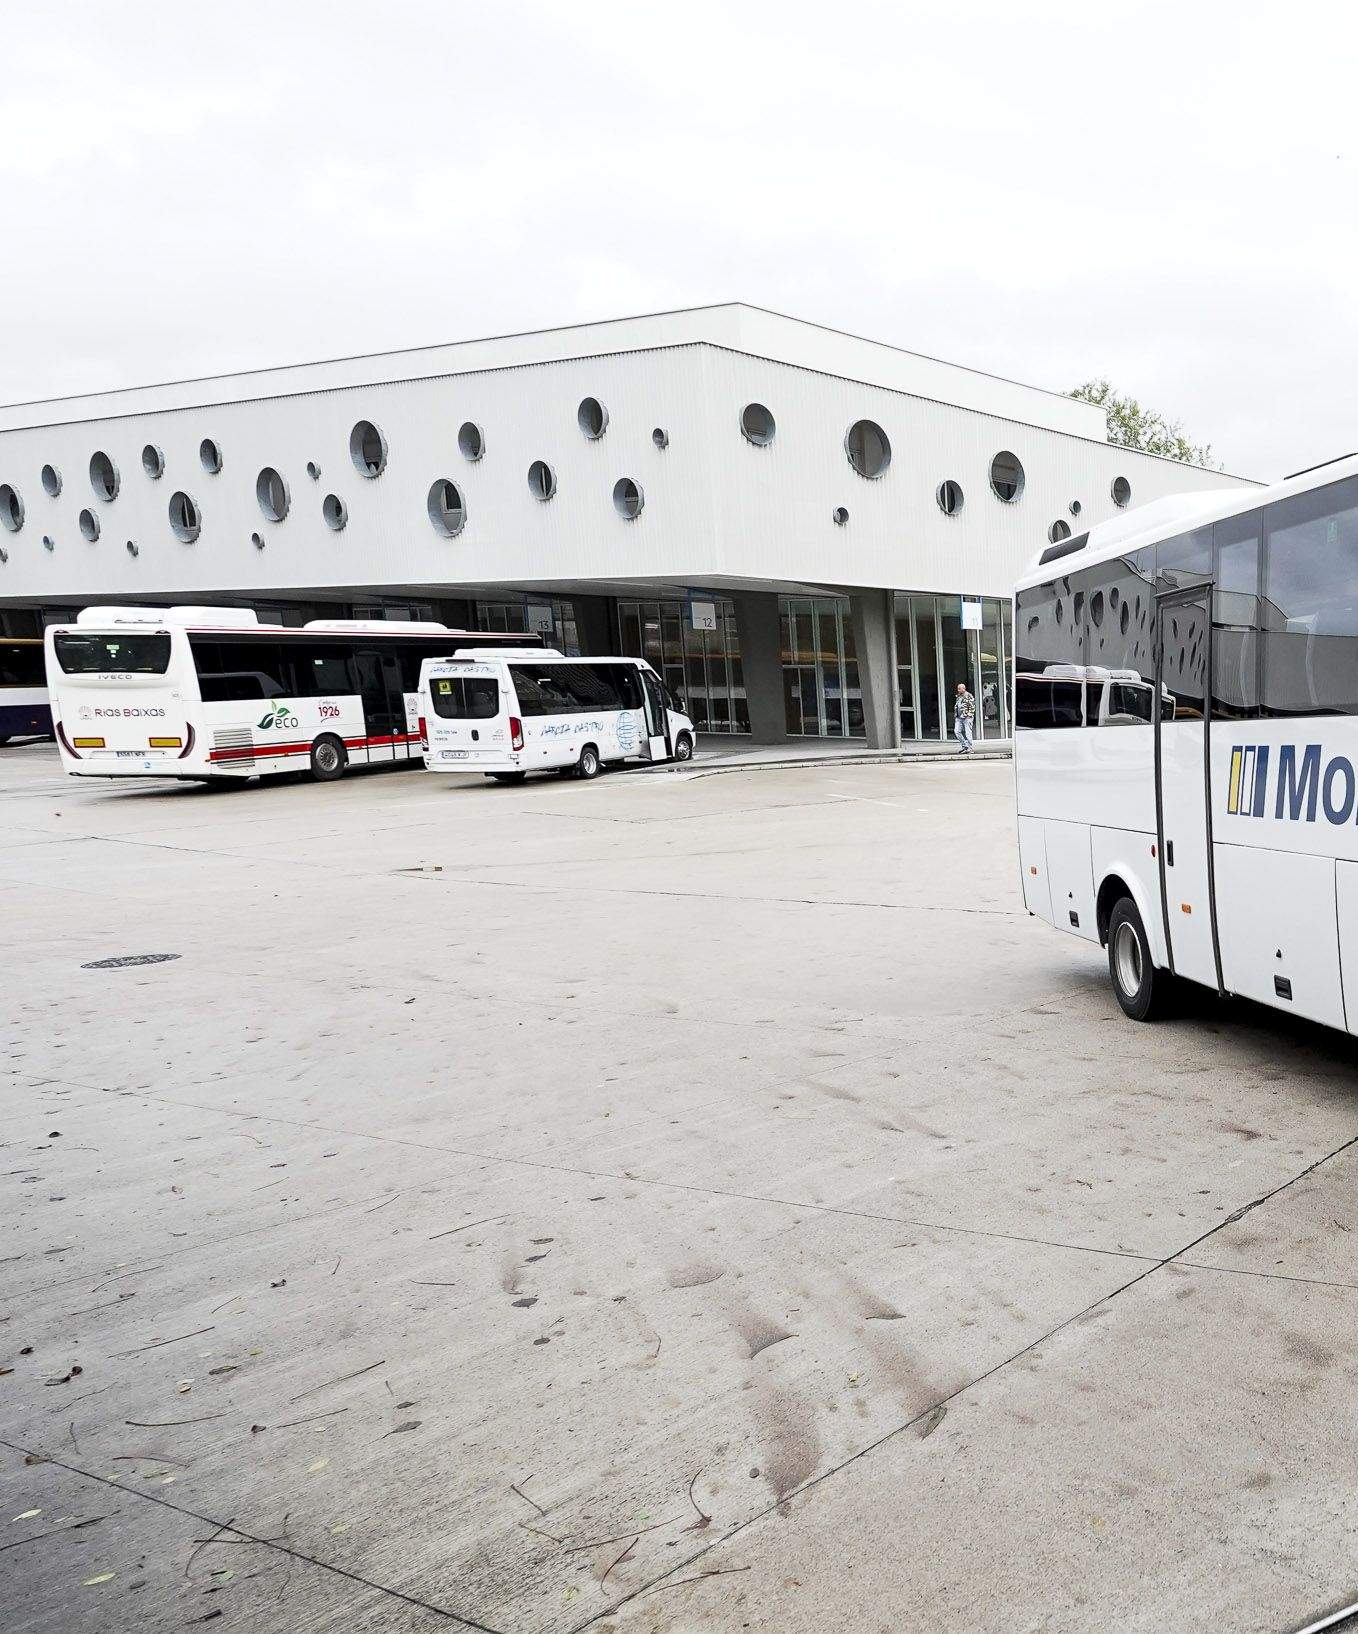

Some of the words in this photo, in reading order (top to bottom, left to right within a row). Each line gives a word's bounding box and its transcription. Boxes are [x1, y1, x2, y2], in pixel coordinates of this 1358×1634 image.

[538, 620, 549, 629] 13
[702, 617, 712, 628] 12
[318, 705, 341, 717] 1926
[275, 717, 299, 729] eco
